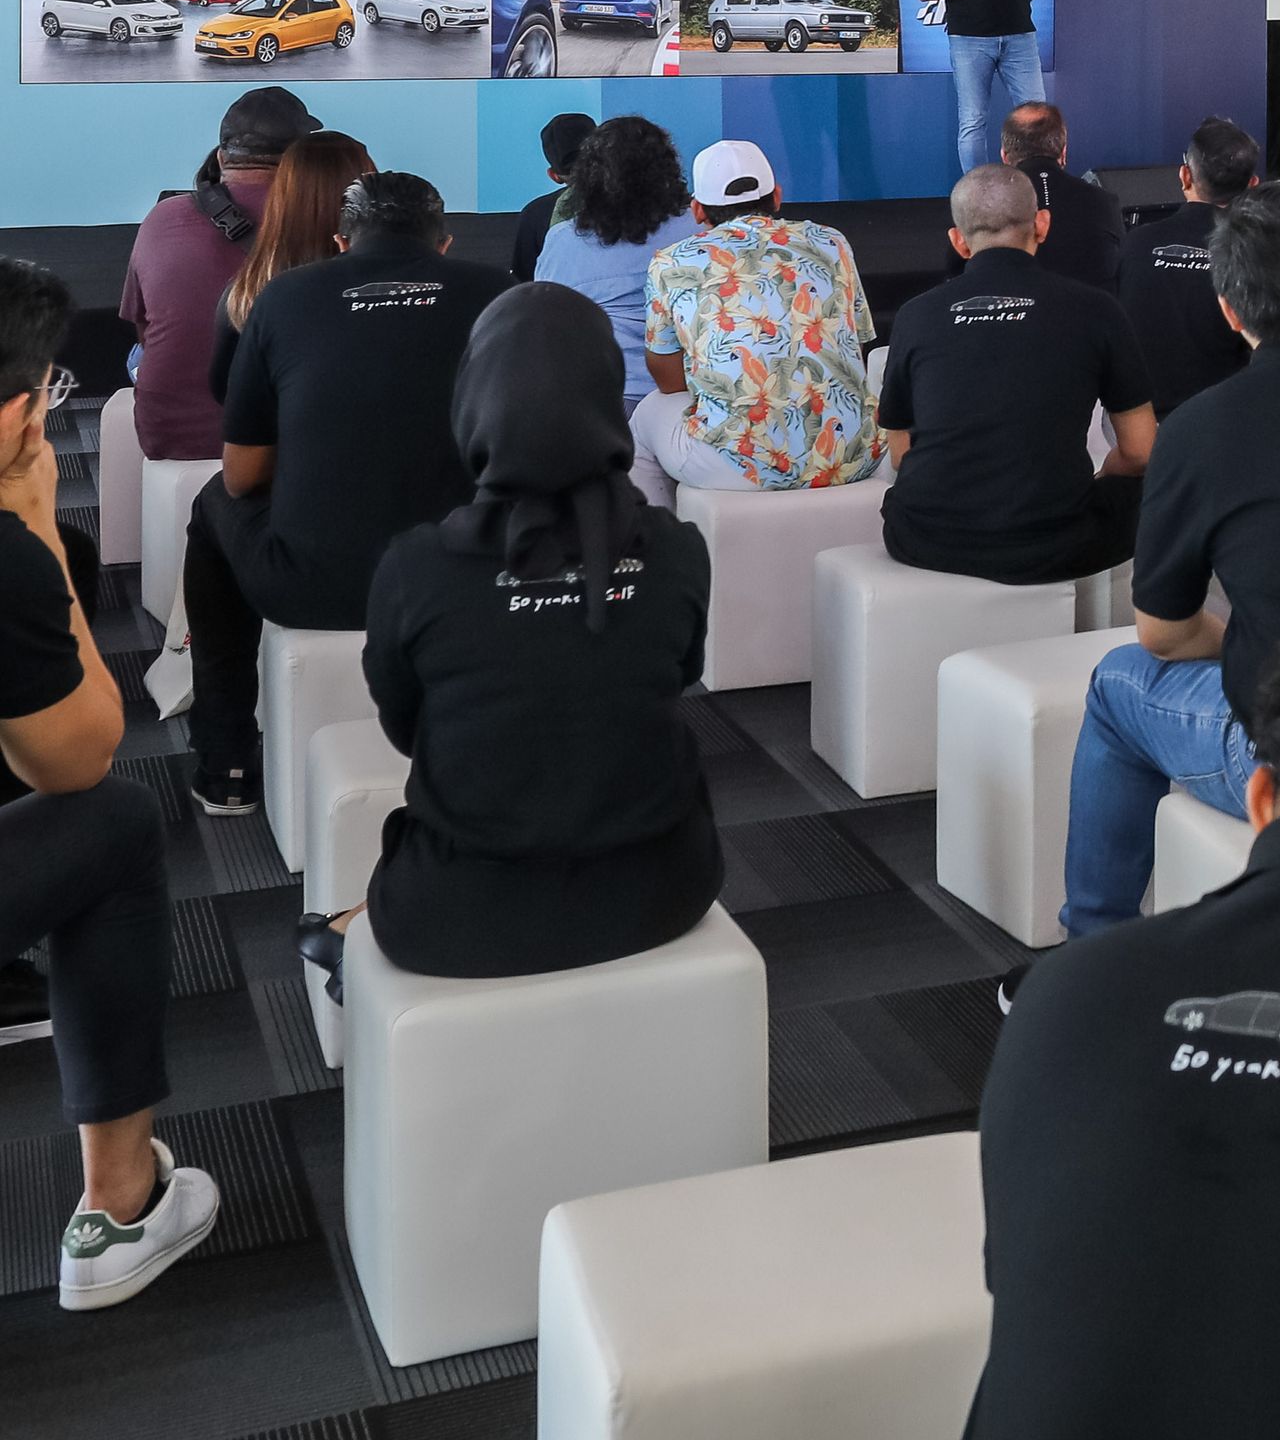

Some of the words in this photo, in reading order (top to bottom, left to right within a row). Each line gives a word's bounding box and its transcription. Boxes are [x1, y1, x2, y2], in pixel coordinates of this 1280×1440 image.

[351, 302, 365, 311] 50
[954, 315, 967, 324] 50
[509, 595, 531, 612] 50
[1170, 1043, 1210, 1072] 50
